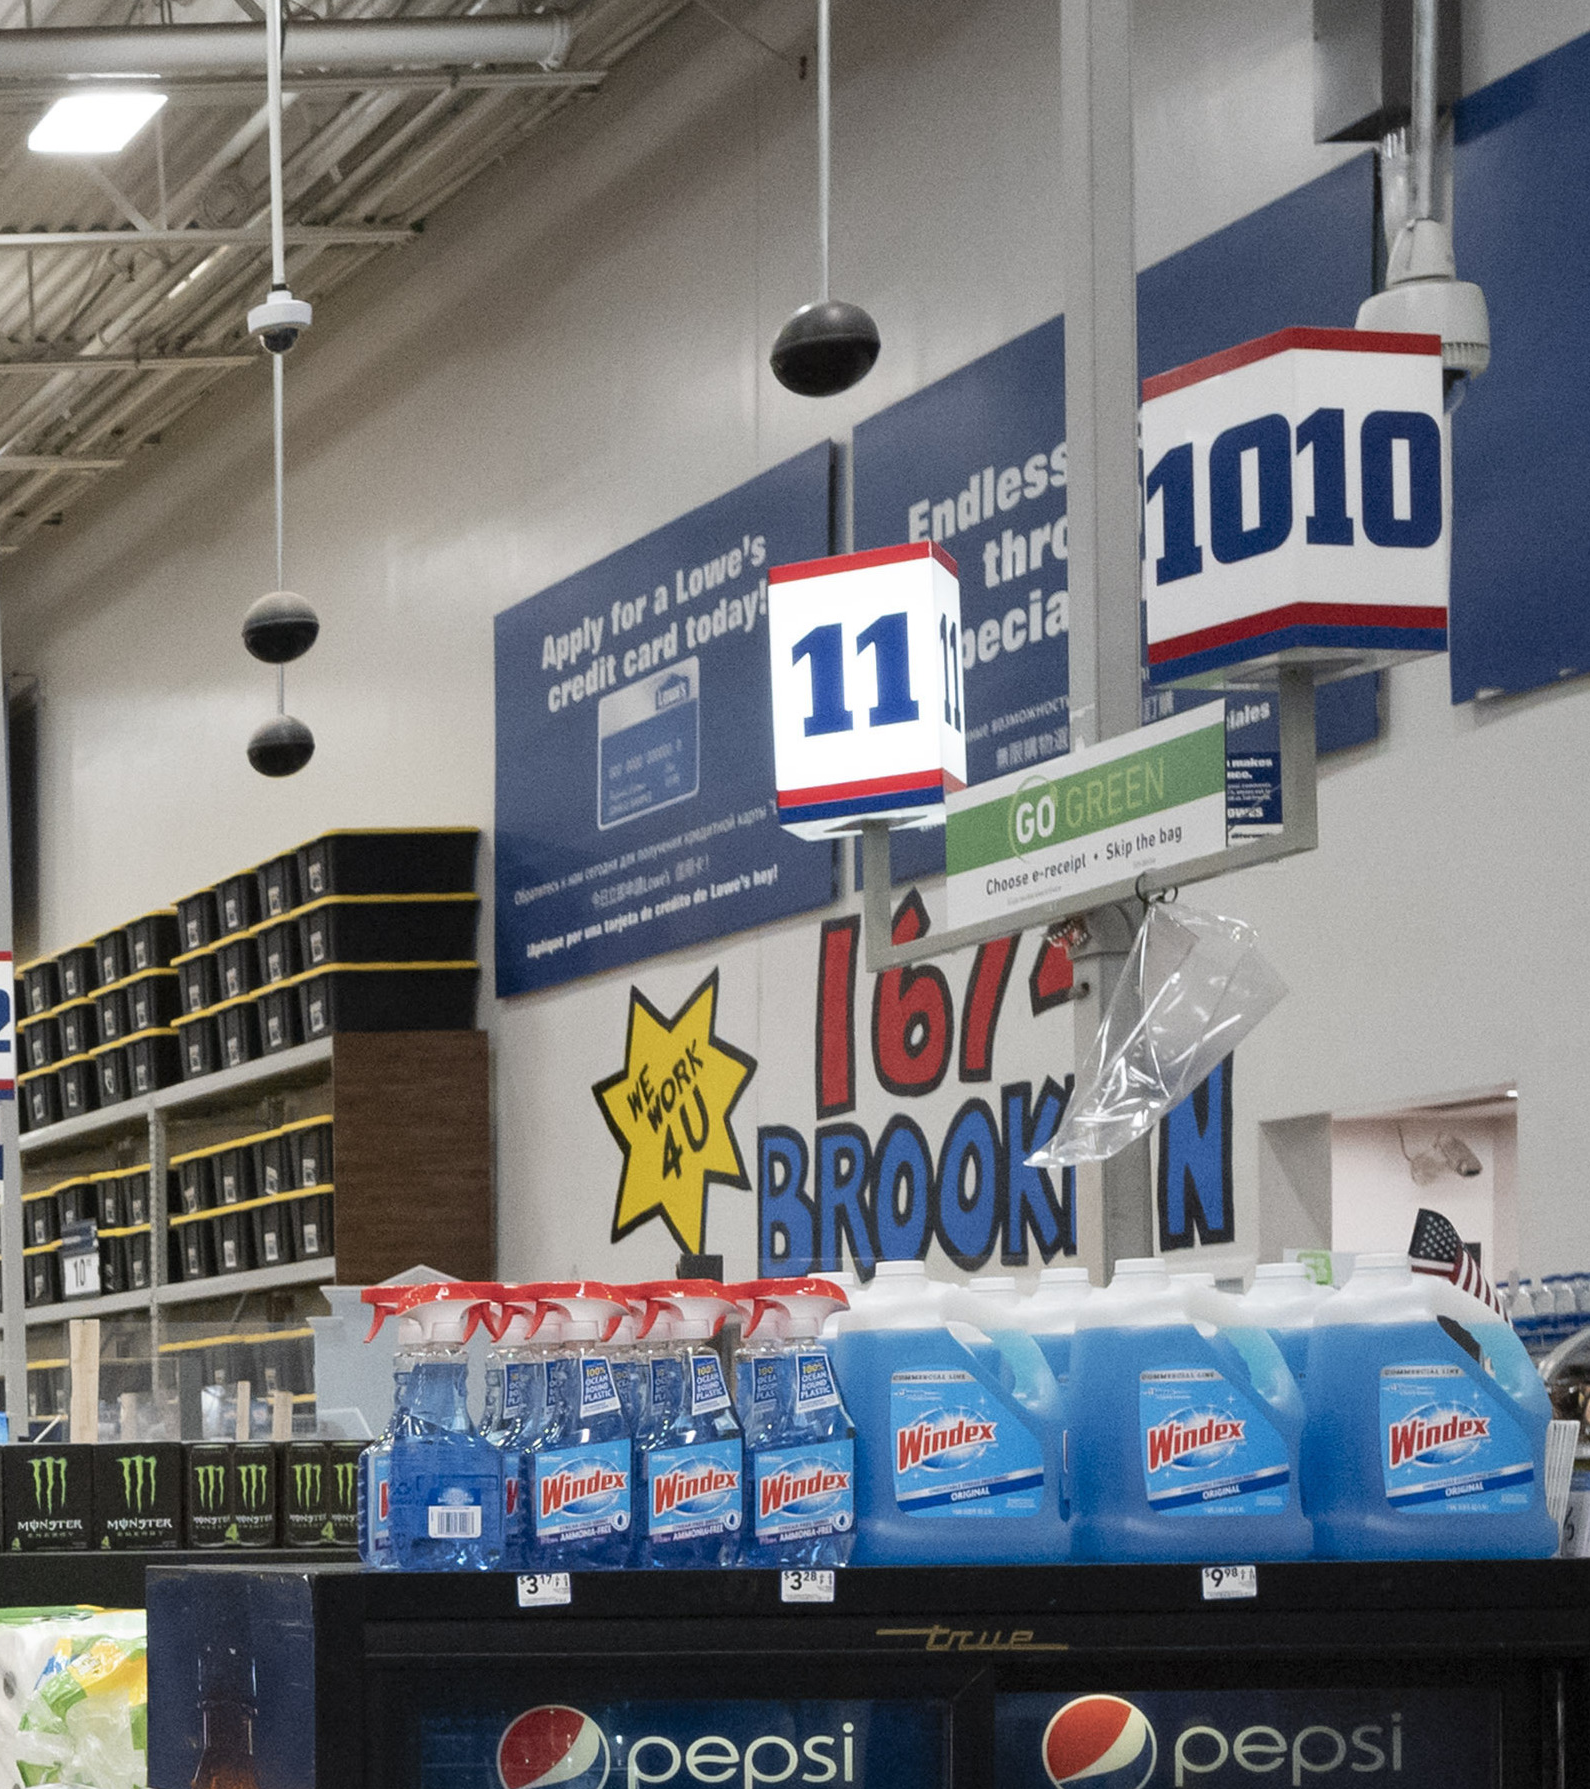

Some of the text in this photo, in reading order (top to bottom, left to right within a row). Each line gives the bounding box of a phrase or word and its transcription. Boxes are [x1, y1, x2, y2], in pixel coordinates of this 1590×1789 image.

[908, 442, 1069, 542] Endless
[1145, 412, 1294, 587] 10
[1295, 407, 1443, 549] 10
[541, 534, 767, 671] Apply for a Lowe's
[547, 577, 768, 714] credit card today!
[792, 612, 920, 738] 11
[939, 611, 963, 736] 11
[1015, 794, 1057, 844] GO
[1064, 756, 1165, 830] GREEN
[986, 874, 1029, 896] Choose
[1031, 852, 1087, 884] e-receipt
[1105, 840, 1133, 861] Skip
[1135, 833, 1156, 852] the
[1159, 824, 1183, 844] bag
[627, 1063, 654, 1122] WE
[646, 1043, 705, 1130] WORK
[585, 1375, 609, 1386] OCEAN
[696, 1373, 719, 1384] OCEAN
[801, 1371, 827, 1382] OCEAN
[801, 1379, 827, 1391] BOUND
[802, 1363, 824, 1373] 100%
[584, 1390, 613, 1402] PLASTIC
[695, 1388, 724, 1401] PLASTIC
[800, 1387, 829, 1401] PLASTIC
[897, 1419, 996, 1474] Windex
[1148, 1418, 1244, 1473] Windex
[1390, 1415, 1489, 1468] Windex
[540, 1468, 626, 1518] Windex
[654, 1468, 738, 1517] Windex
[758, 1468, 850, 1517] Windex
[951, 1486, 990, 1501] ORIGINAL
[1202, 1484, 1240, 1500] ORIGINAL
[1444, 1482, 1485, 1498] ORIGINAL
[17, 1518, 83, 1532] MONSTER
[107, 1517, 173, 1531] MONSTER
[559, 1526, 612, 1543] AMMONIA-FREE
[672, 1524, 724, 1541] AMMONIA-FREE
[778, 1525, 833, 1543] AMMONIA-FREE
[905, 1624, 1050, 1652] true
[1174, 1712, 1403, 1787] pepsi
